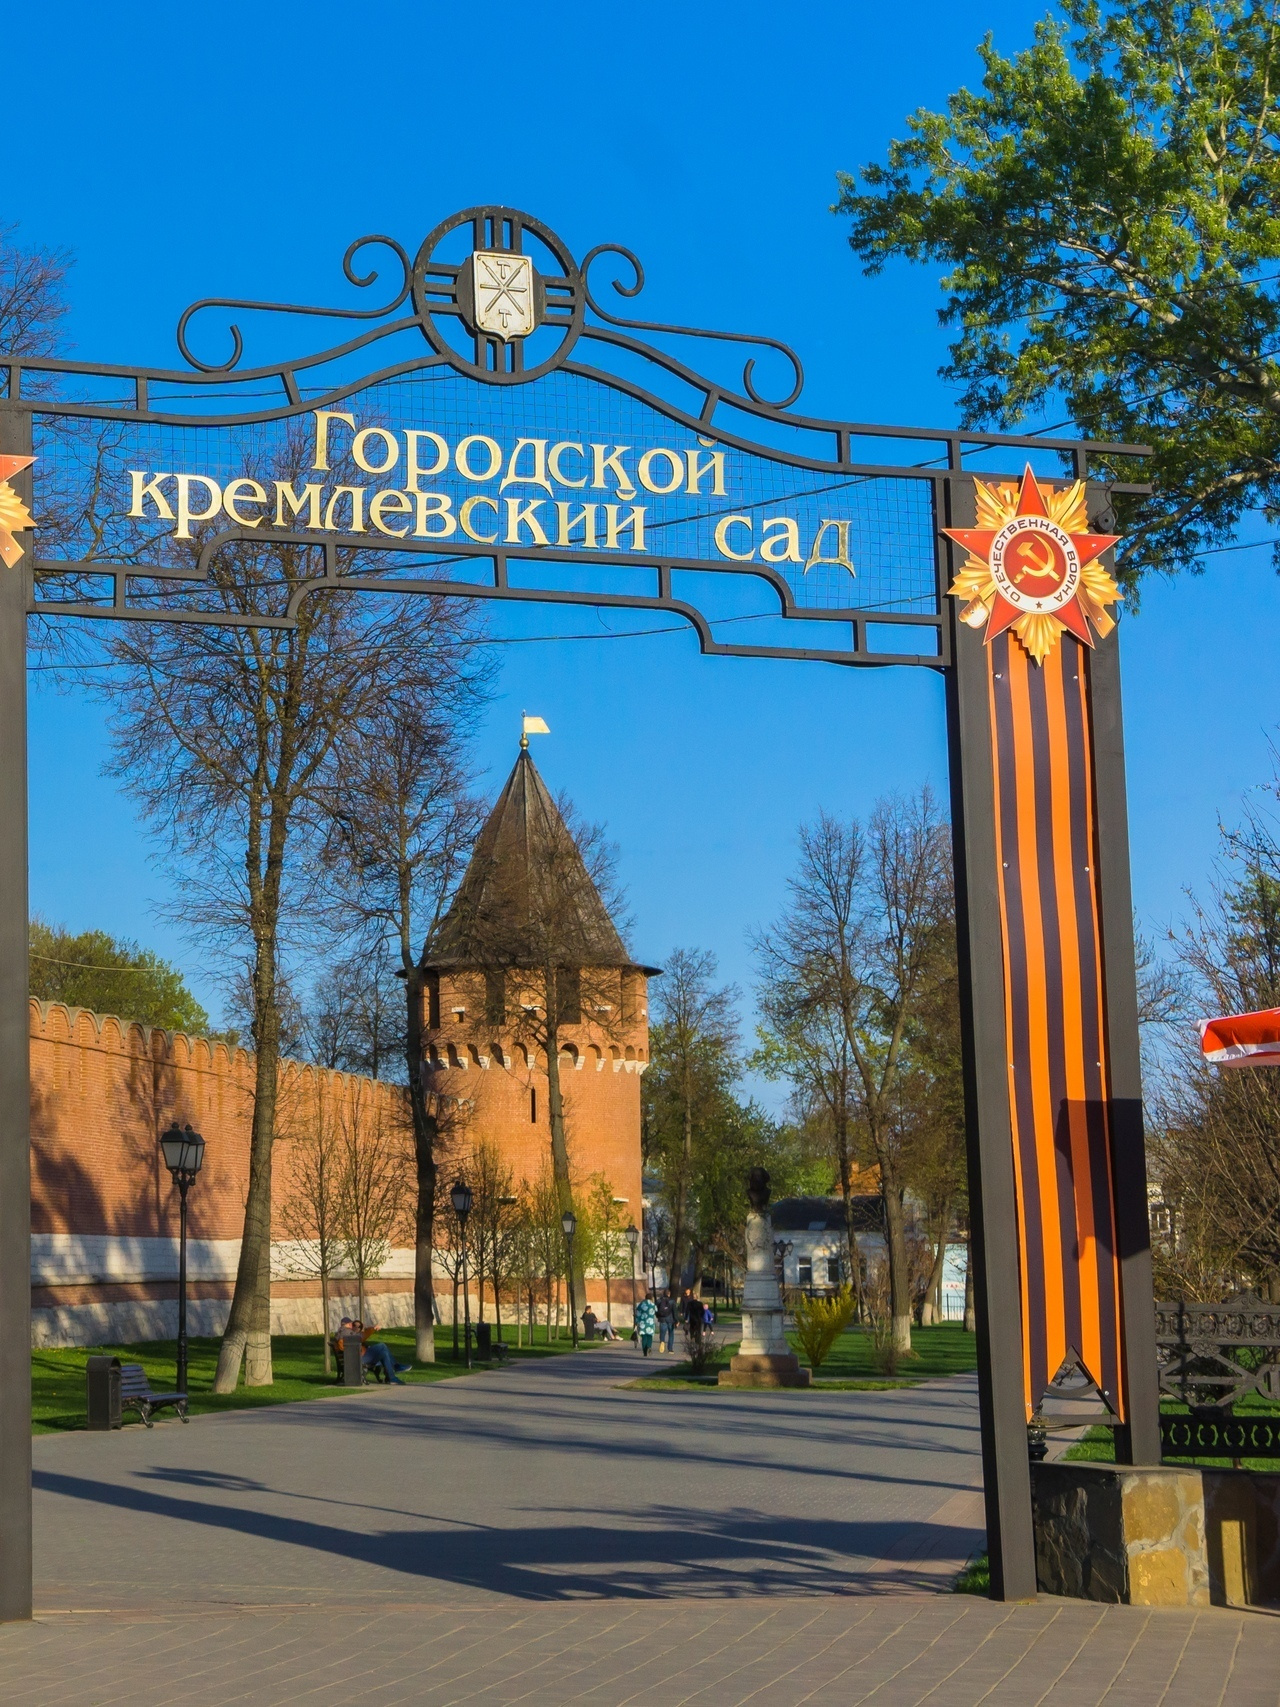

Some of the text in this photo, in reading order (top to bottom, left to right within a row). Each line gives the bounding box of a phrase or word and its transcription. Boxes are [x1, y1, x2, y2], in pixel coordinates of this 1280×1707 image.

[310, 410, 729, 498] Городской
[127, 470, 857, 579] кремлевский сад
[992, 518, 1070, 603] ОТЕЧЕСТВЕННАЯ
